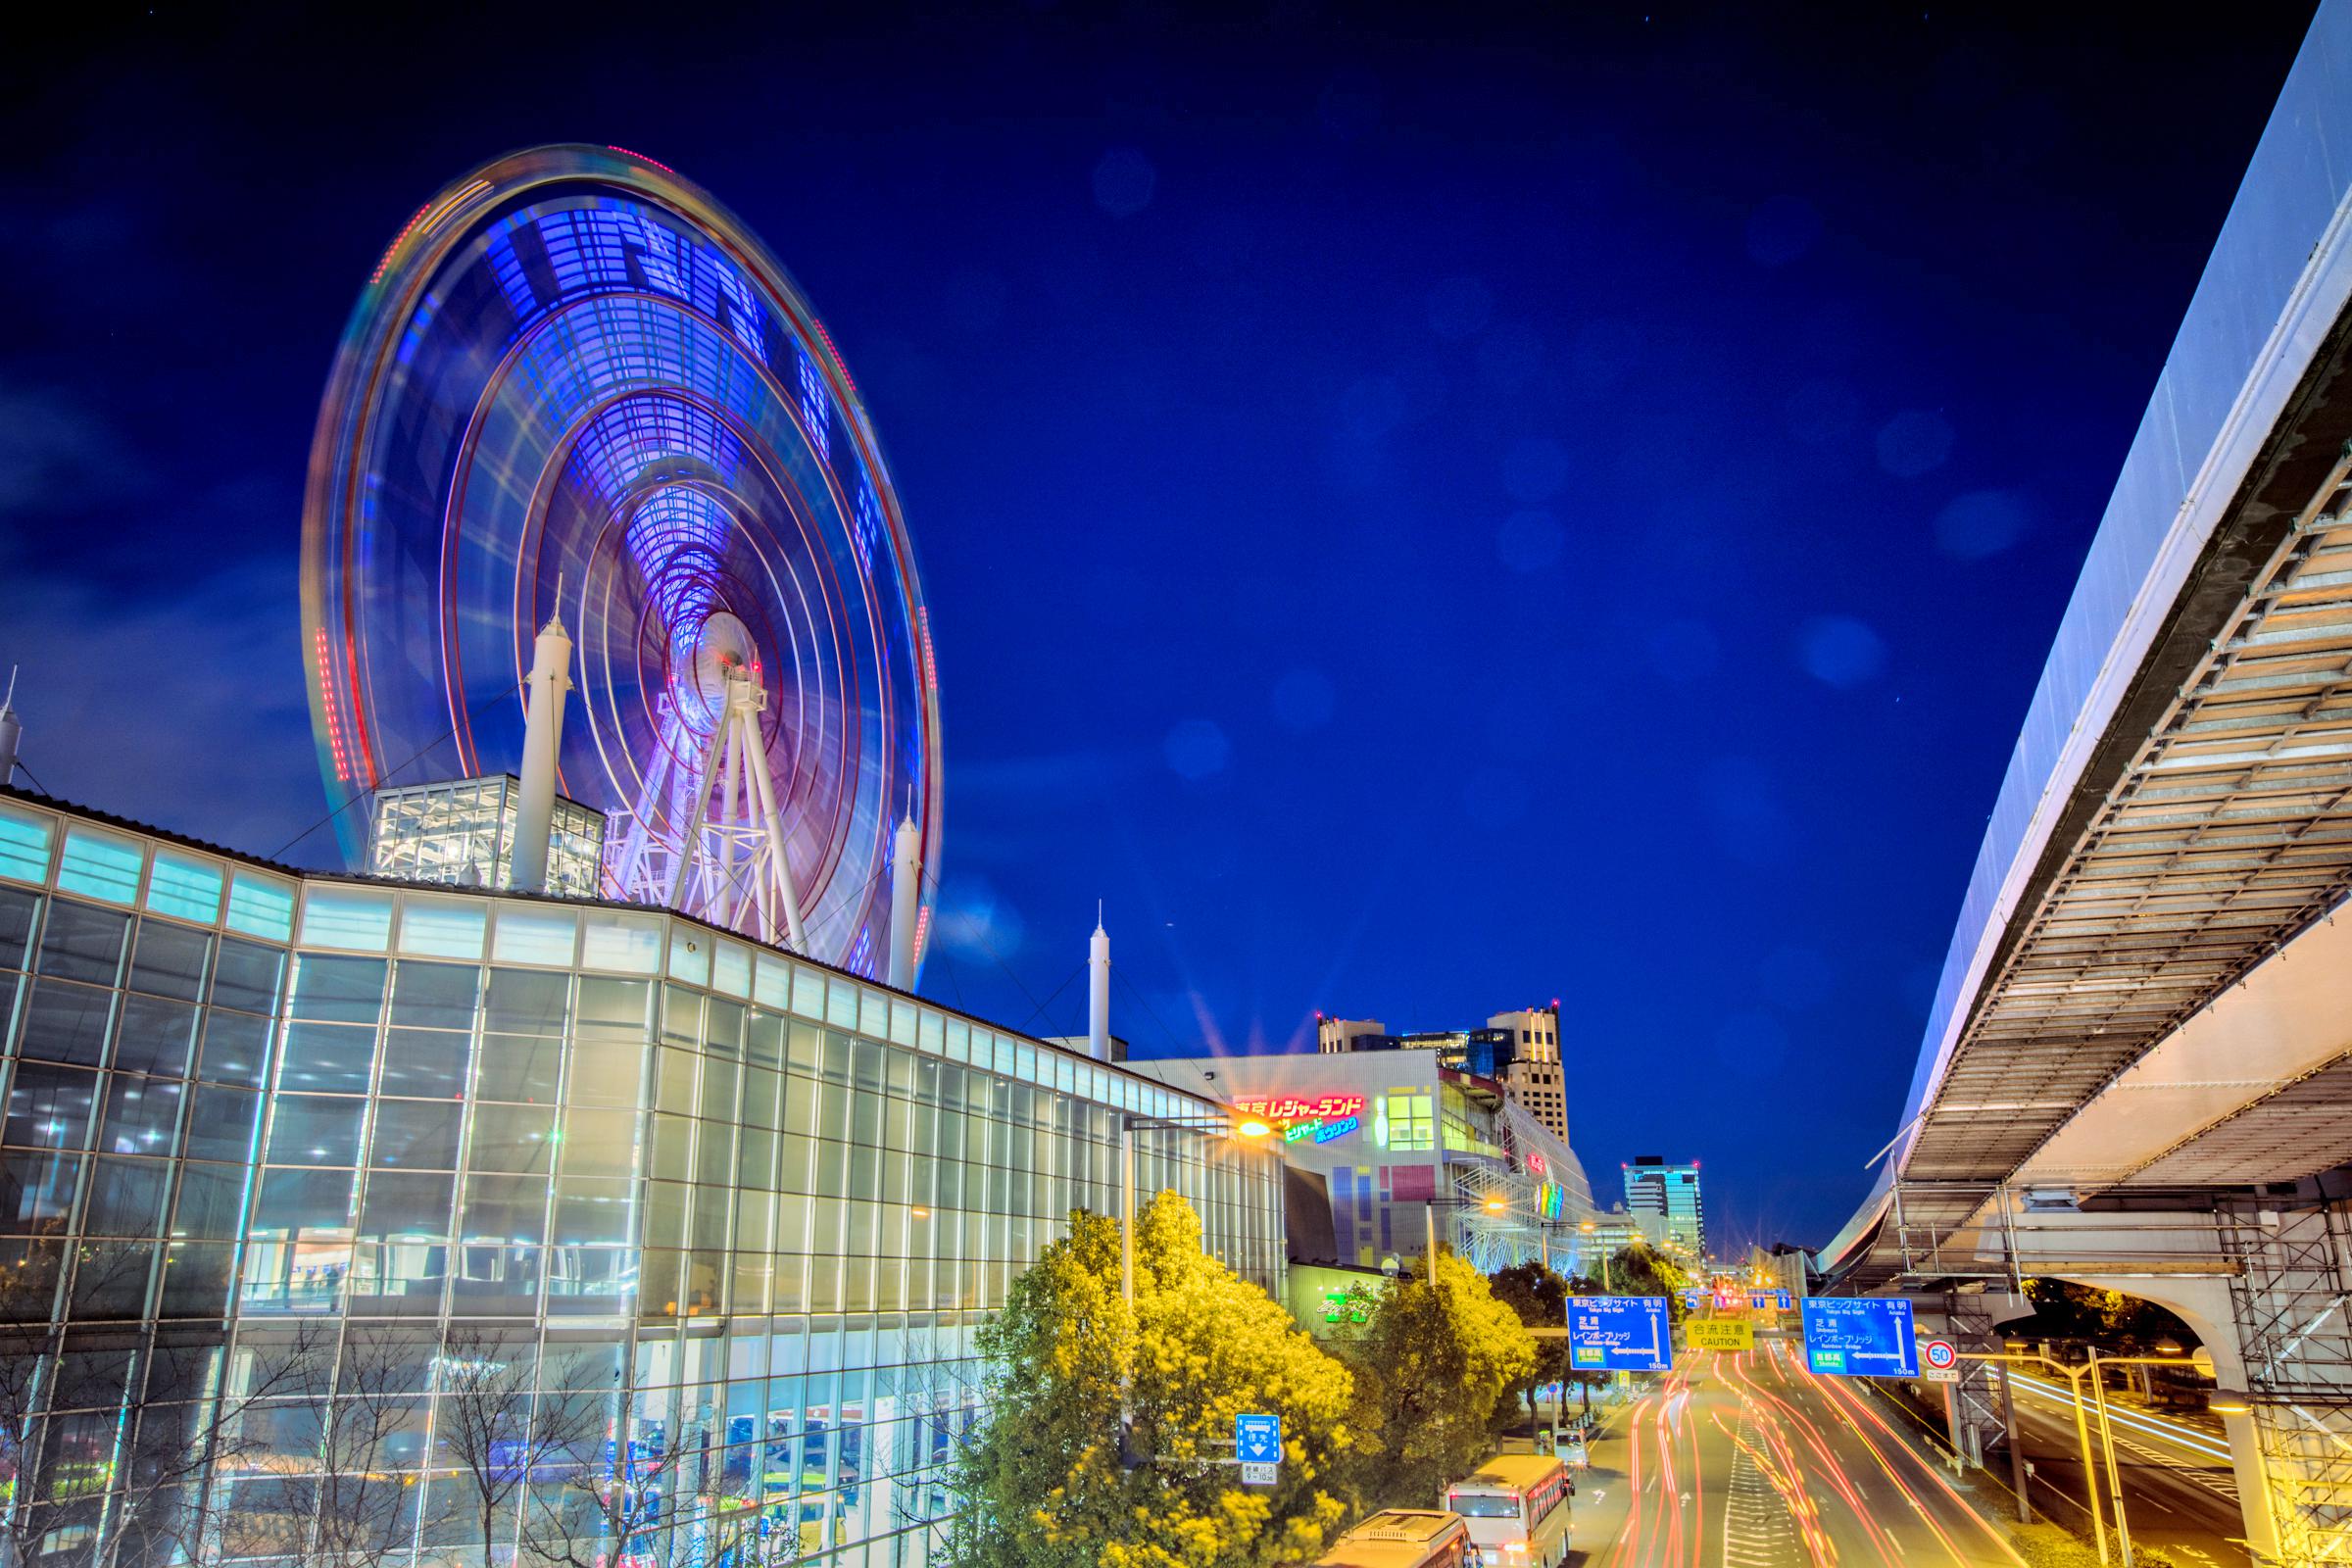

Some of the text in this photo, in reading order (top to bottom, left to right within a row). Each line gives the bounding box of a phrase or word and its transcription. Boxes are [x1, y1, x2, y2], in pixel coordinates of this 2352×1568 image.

[1573, 1298, 1662, 1307] 東京ビッグサイト 有明
[1808, 1299, 1906, 1309] 東京ビッグサイト 有明
[1693, 1324, 1744, 1335] 合流注意
[1573, 1332, 1631, 1341] レインボーブリッジ
[1809, 1335, 1872, 1344] レインボーブリッジ
[1932, 1349, 1949, 1361] 50
